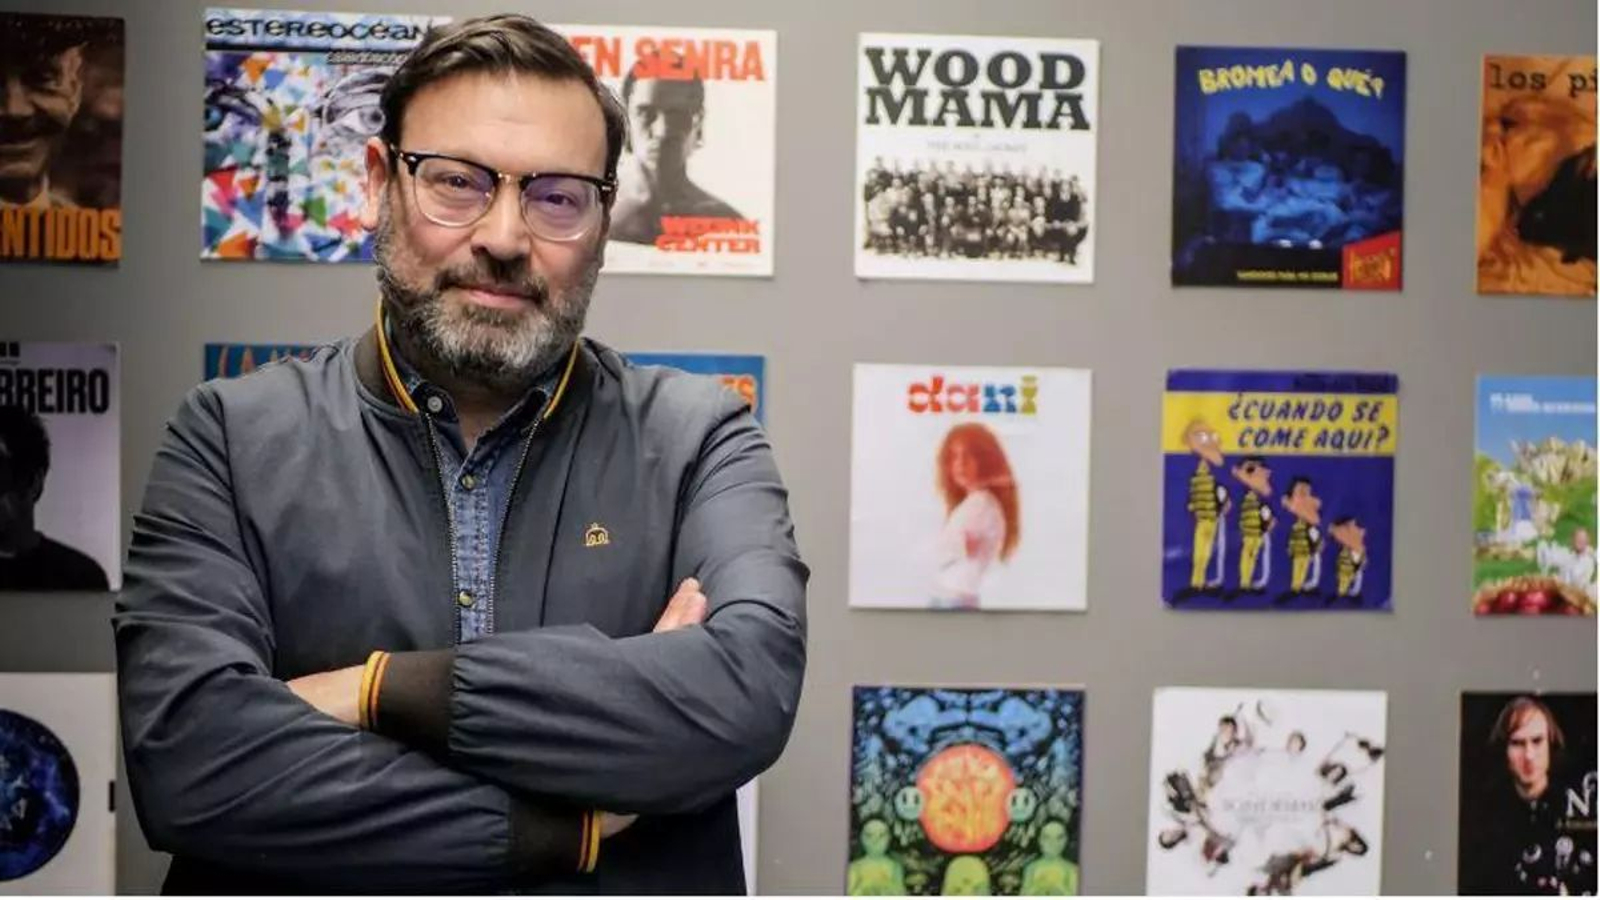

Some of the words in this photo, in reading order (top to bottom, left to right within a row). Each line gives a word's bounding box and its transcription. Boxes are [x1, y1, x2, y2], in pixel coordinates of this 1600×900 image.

[634, 36, 764, 81] SENRA
[865, 47, 1086, 90] WOOD
[1301, 62, 1318, 86] O
[1489, 63, 1547, 90] los
[865, 87, 1091, 130] MAMA
[0, 204, 121, 259] NTIDOS
[908, 375, 1038, 414] dani
[1227, 393, 1344, 422] ¿CUANDO
[1352, 401, 1384, 423] SE
[1238, 426, 1308, 448] COME
